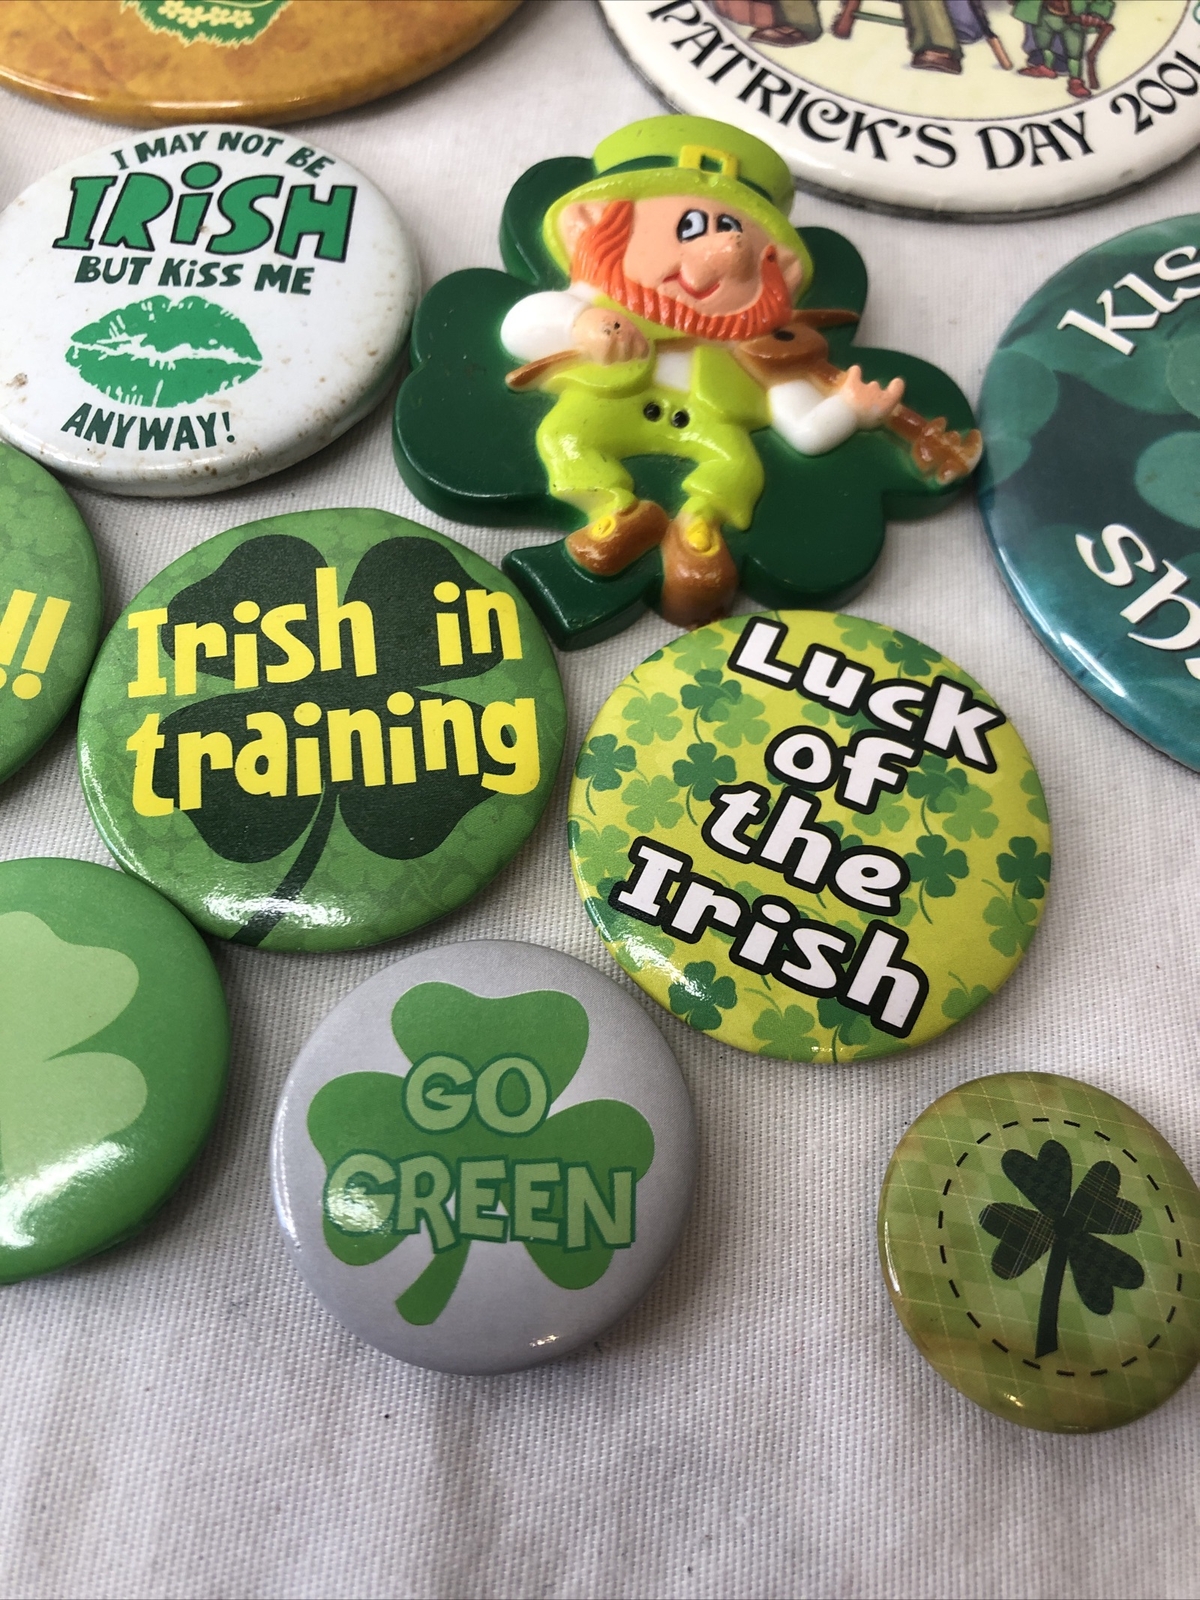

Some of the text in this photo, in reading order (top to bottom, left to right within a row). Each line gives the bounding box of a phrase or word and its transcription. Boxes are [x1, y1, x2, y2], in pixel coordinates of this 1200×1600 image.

[646, 0, 1200, 170] PATRICK'S DAY 2001
[111, 130, 335, 178] I MAY NOT BE
[74, 256, 153, 285] BUT
[254, 264, 315, 295] ME
[61, 402, 236, 452] ANYWAY!
[127, 566, 523, 698] Irish in
[728, 616, 1006, 774] Luck
[126, 691, 541, 817] training
[764, 725, 922, 815] of
[701, 781, 910, 916] the
[608, 836, 930, 1039] Irish
[402, 1051, 553, 1138] GO
[323, 1149, 637, 1254] GREEN
